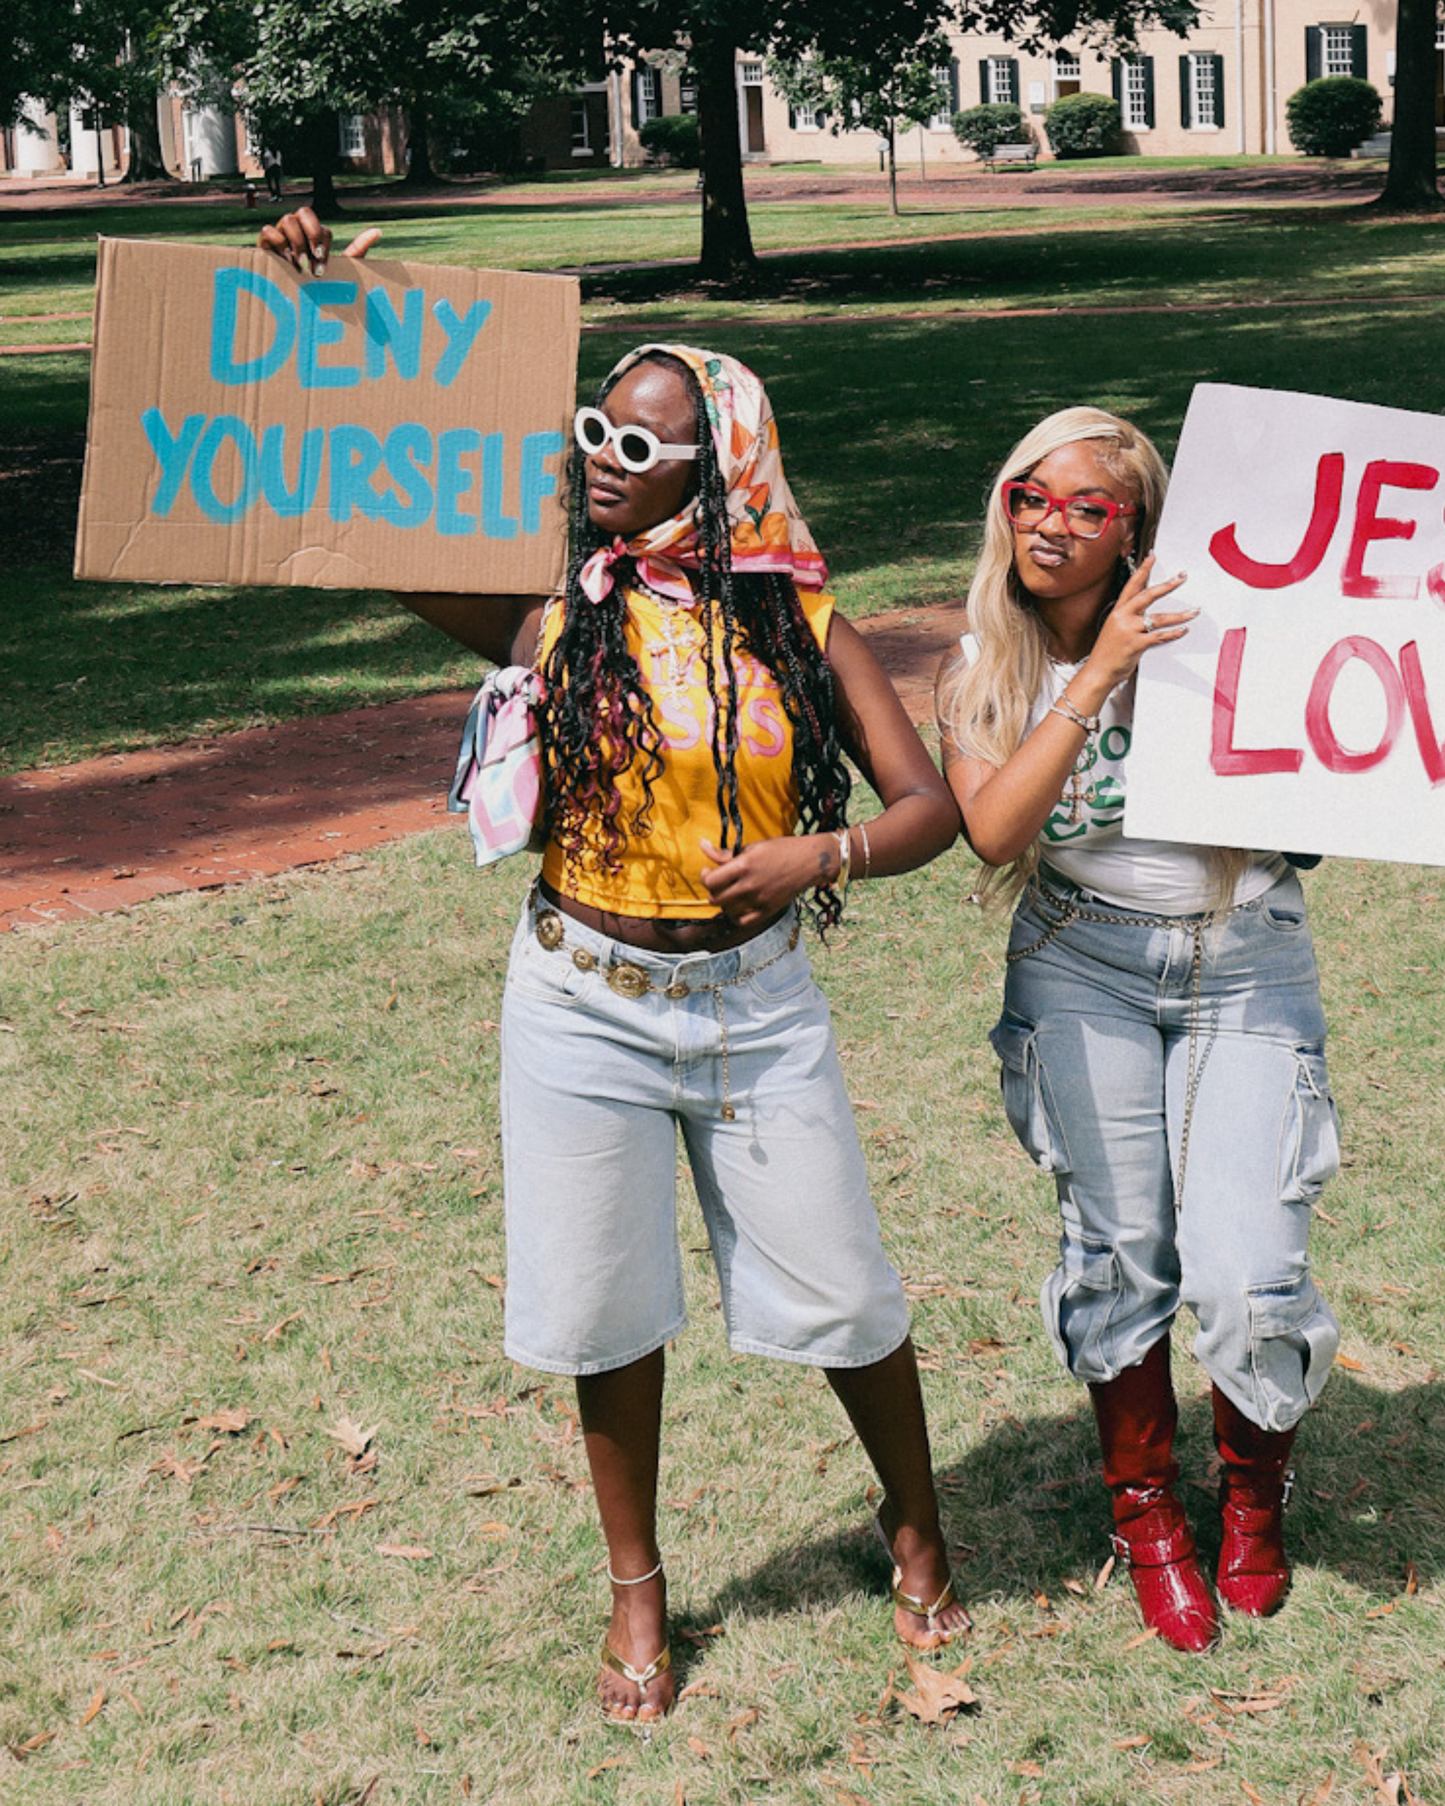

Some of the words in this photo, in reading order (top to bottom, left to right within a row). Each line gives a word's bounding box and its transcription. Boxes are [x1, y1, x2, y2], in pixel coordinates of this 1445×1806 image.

[209, 266, 493, 389] DENY
[140, 406, 566, 539] YOURSELF
[1208, 452, 1445, 609] JE
